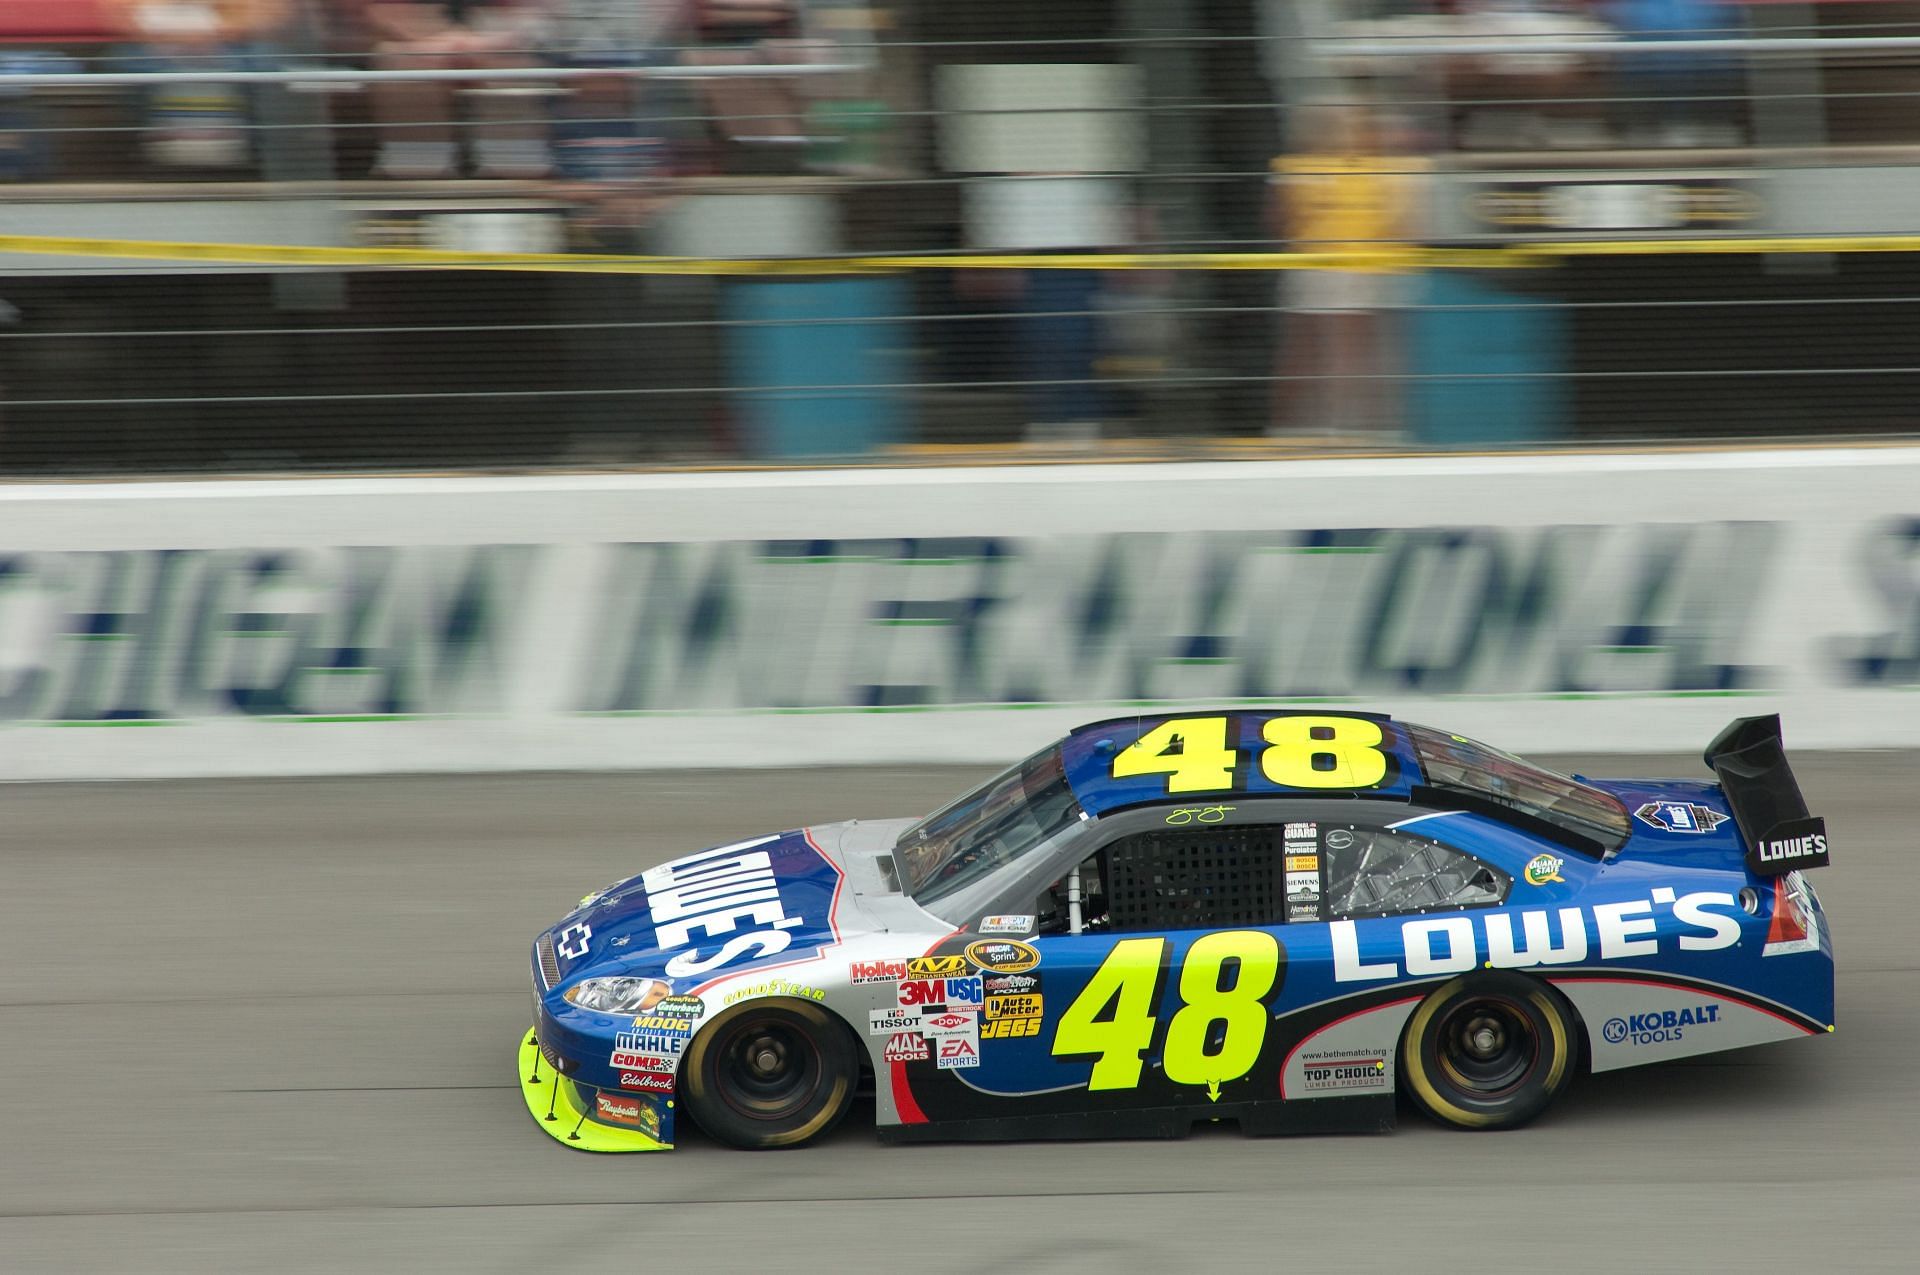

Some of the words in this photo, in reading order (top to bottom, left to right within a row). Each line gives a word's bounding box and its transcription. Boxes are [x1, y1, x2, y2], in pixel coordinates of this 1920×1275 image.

[1113, 716, 1387, 793] 48
[1285, 828, 1317, 838] GUARD
[1285, 847, 1318, 855] Purolator
[1759, 834, 1828, 862] LOWE'S
[1530, 859, 1564, 869] QUAKER
[1535, 866, 1560, 876] STATE
[641, 835, 803, 978] LOWE'S
[1329, 887, 1742, 983] LOWE'S
[987, 945, 1011, 953] NASCAR
[991, 952, 1016, 963] Sprint
[851, 960, 907, 980] Holley
[909, 972, 946, 980] MECHANIX
[946, 969, 967, 978] WEAR
[867, 975, 897, 983] CARBS
[724, 979, 826, 1005] GOODYEAR
[899, 979, 946, 1006] 3M
[947, 977, 982, 1004] USG
[657, 1000, 703, 1012] Gatorback
[1003, 997, 1033, 1007] Auto
[658, 1011, 699, 1019] BELTS
[999, 1006, 1040, 1017] Meter
[1051, 929, 1279, 1092] 48
[1630, 1004, 1719, 1032] KOBALT
[632, 1016, 691, 1031] MOOG
[871, 1017, 922, 1029] TISSOT
[980, 1017, 1042, 1038] JEGS
[616, 1033, 681, 1054] MAHLE
[885, 1033, 928, 1053] MAC
[1630, 1028, 1683, 1045] TOOLS
[940, 1039, 976, 1058] EA
[1302, 1048, 1387, 1060] www.bethematch.org
[613, 1053, 662, 1068] COMP
[886, 1052, 929, 1062] TOOLS
[939, 1056, 978, 1067] SPORTS
[620, 1073, 673, 1089] Edelbrock
[1304, 1069, 1331, 1081] TOP
[1335, 1066, 1385, 1079] CHOICE
[1341, 1078, 1385, 1086] PRODUCTS
